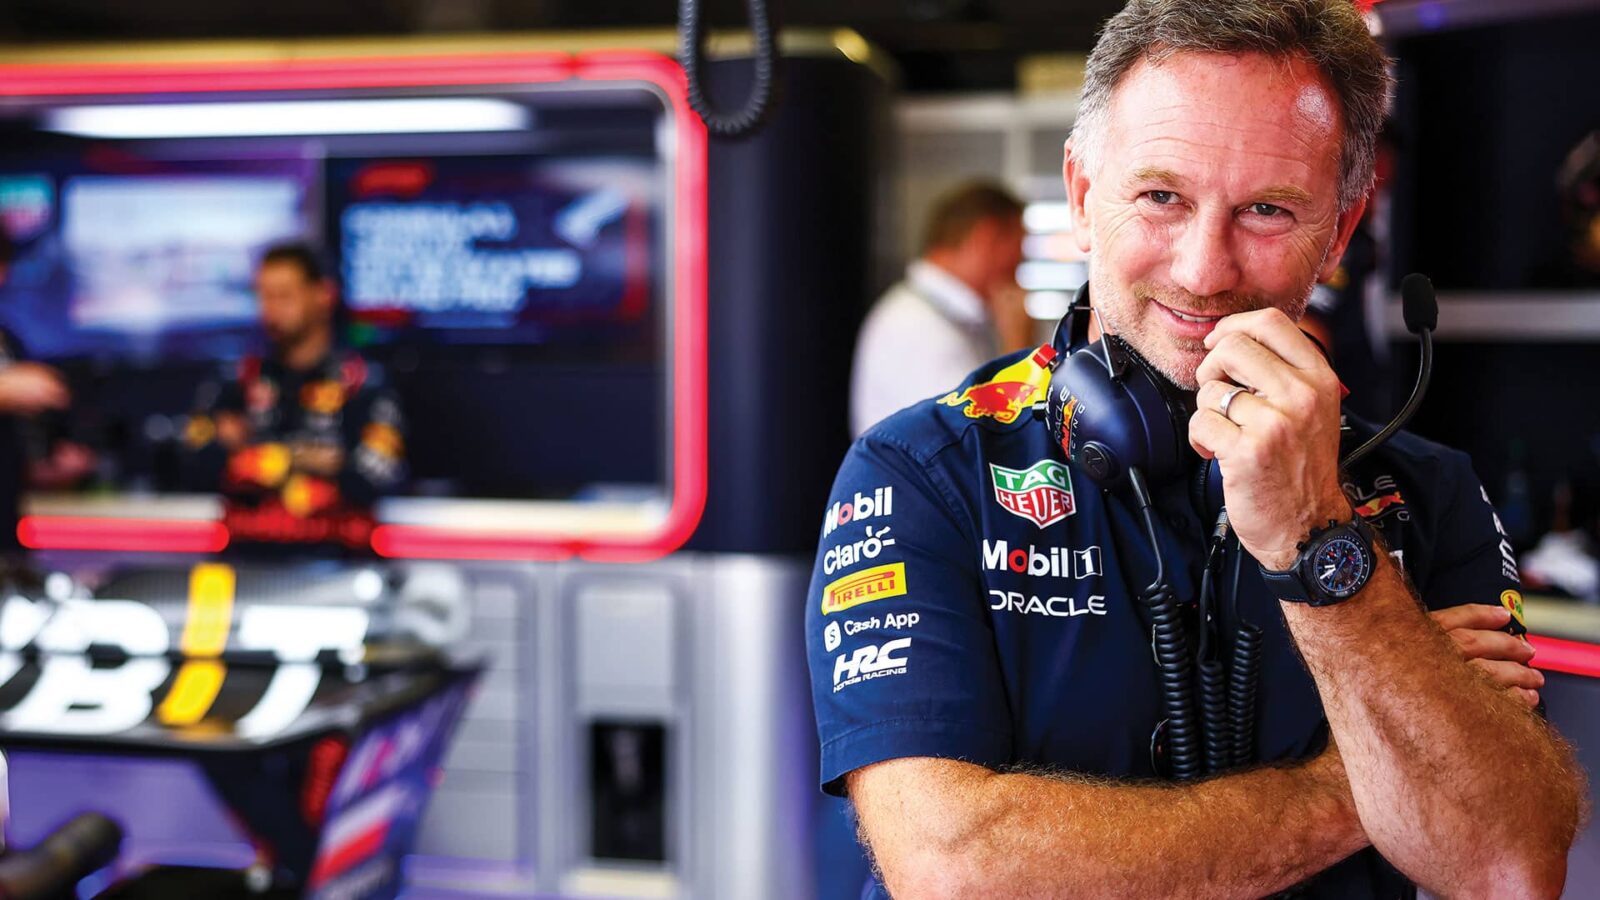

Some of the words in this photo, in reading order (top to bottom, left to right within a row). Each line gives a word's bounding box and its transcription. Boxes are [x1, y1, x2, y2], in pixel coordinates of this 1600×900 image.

[997, 466, 1066, 490] TAG
[823, 486, 893, 539] Mobil
[1000, 488, 1071, 521] HEUER
[824, 537, 882, 575] Claro
[982, 539, 1069, 577] Mobil
[829, 571, 896, 606] PIRELLI
[989, 589, 1107, 617] ORACLE
[843, 616, 881, 636] Cash
[883, 612, 920, 630] App
[833, 637, 912, 687] HRC
[862, 667, 907, 681] RACING
